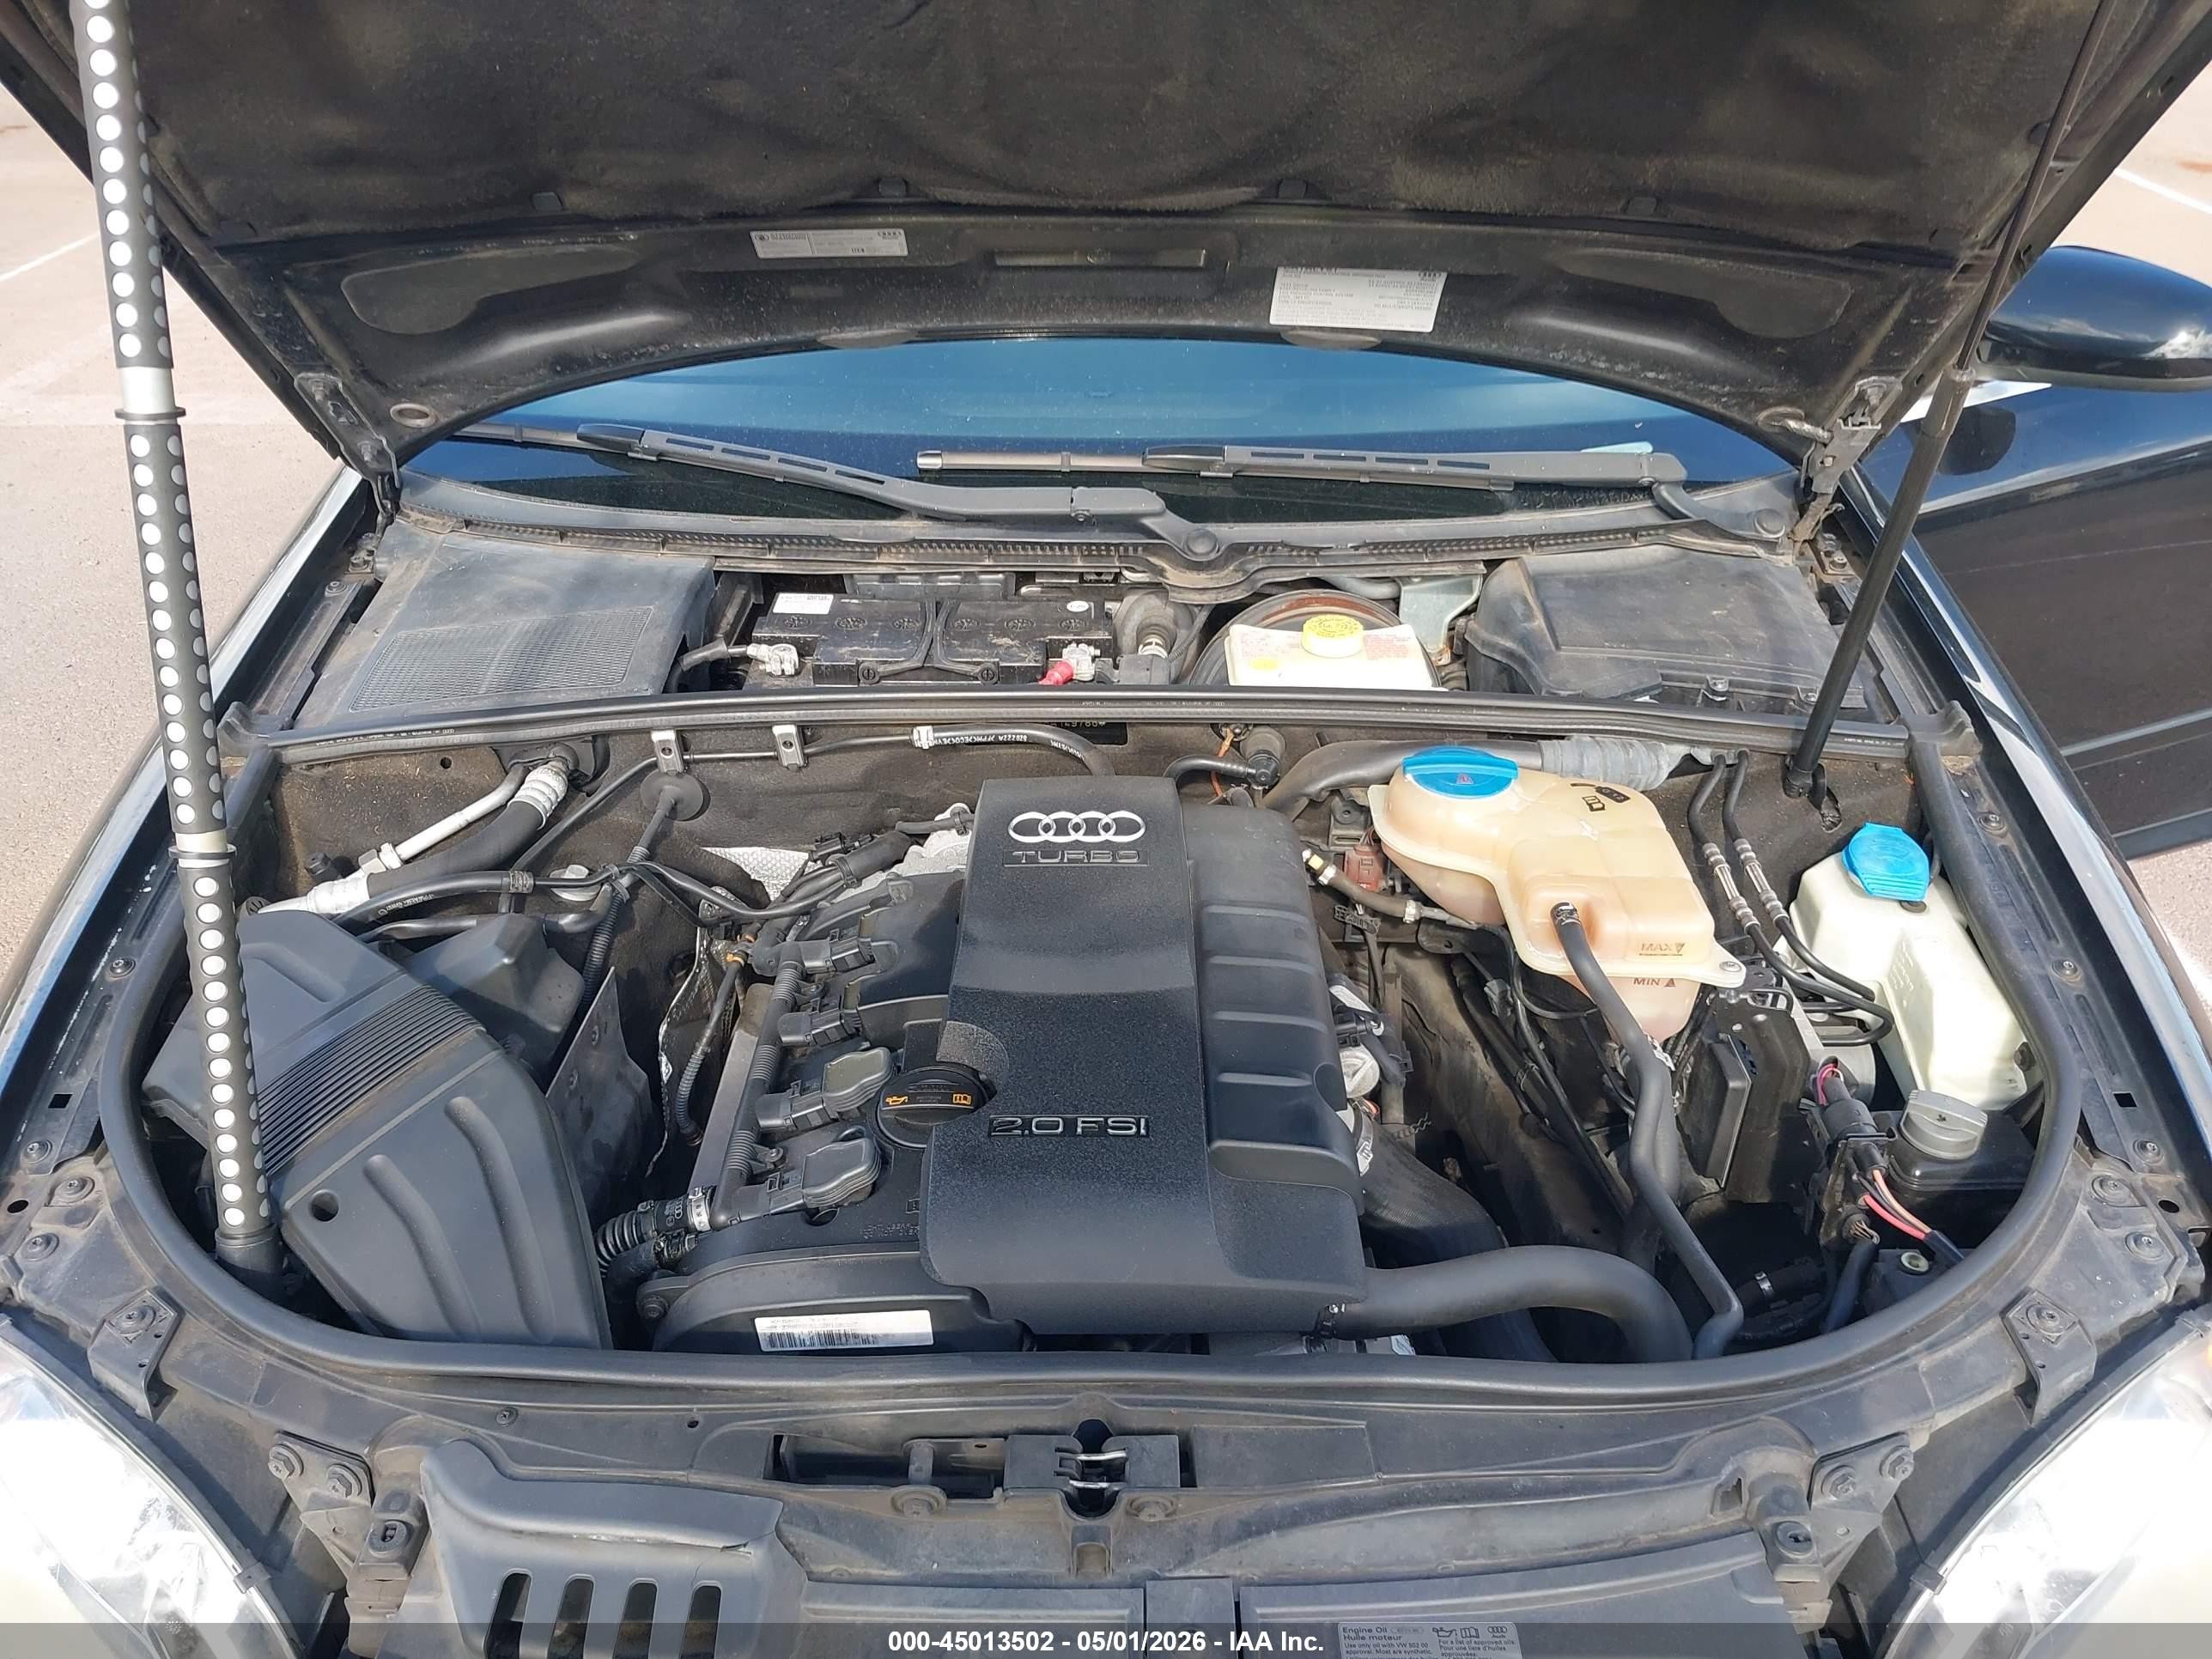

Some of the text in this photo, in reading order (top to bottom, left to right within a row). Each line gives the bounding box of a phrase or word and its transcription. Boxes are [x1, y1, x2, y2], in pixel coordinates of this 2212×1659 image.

[1012, 849, 1139, 863] TURBO
[1640, 943, 1673, 951] MAX
[1633, 977, 1661, 986] MIN
[990, 1116, 1147, 1136] 2.0 FSI
[1342, 1626, 1373, 1635] Engine
